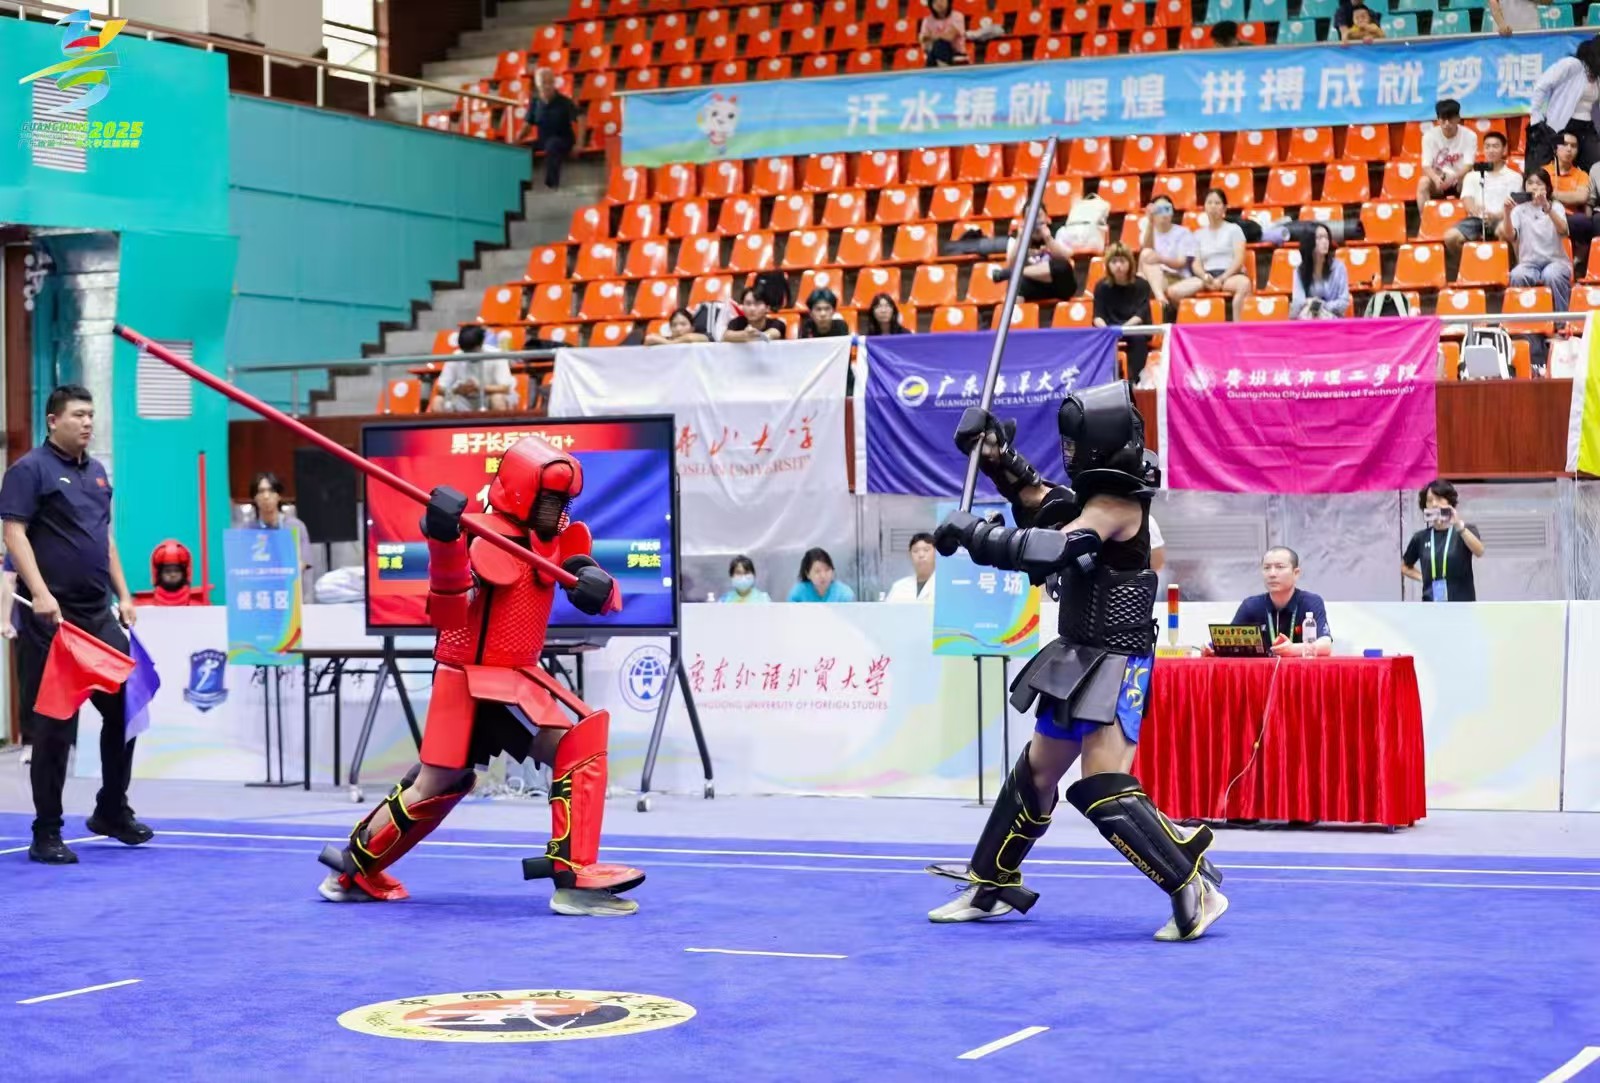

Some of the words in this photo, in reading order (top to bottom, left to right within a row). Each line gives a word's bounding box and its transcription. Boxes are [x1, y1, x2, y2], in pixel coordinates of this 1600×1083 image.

[847, 74, 1166, 135] 汗水铸就辉煌
[1201, 53, 1543, 115] 拼搏成就梦想
[1282, 389, 1300, 400] City
[1302, 388, 1350, 399] University
[935, 398, 981, 408] GUANGDO
[994, 395, 1025, 406] OCEAN
[680, 462, 724, 475] OSHAN
[951, 572, 1023, 595] 一号场
[745, 700, 793, 710] UNIVERSITY
[796, 700, 808, 709] OF
[810, 700, 849, 710] FOREIGN
[852, 699, 889, 710] STUDIES
[1109, 832, 1165, 884] PRETORIAN
